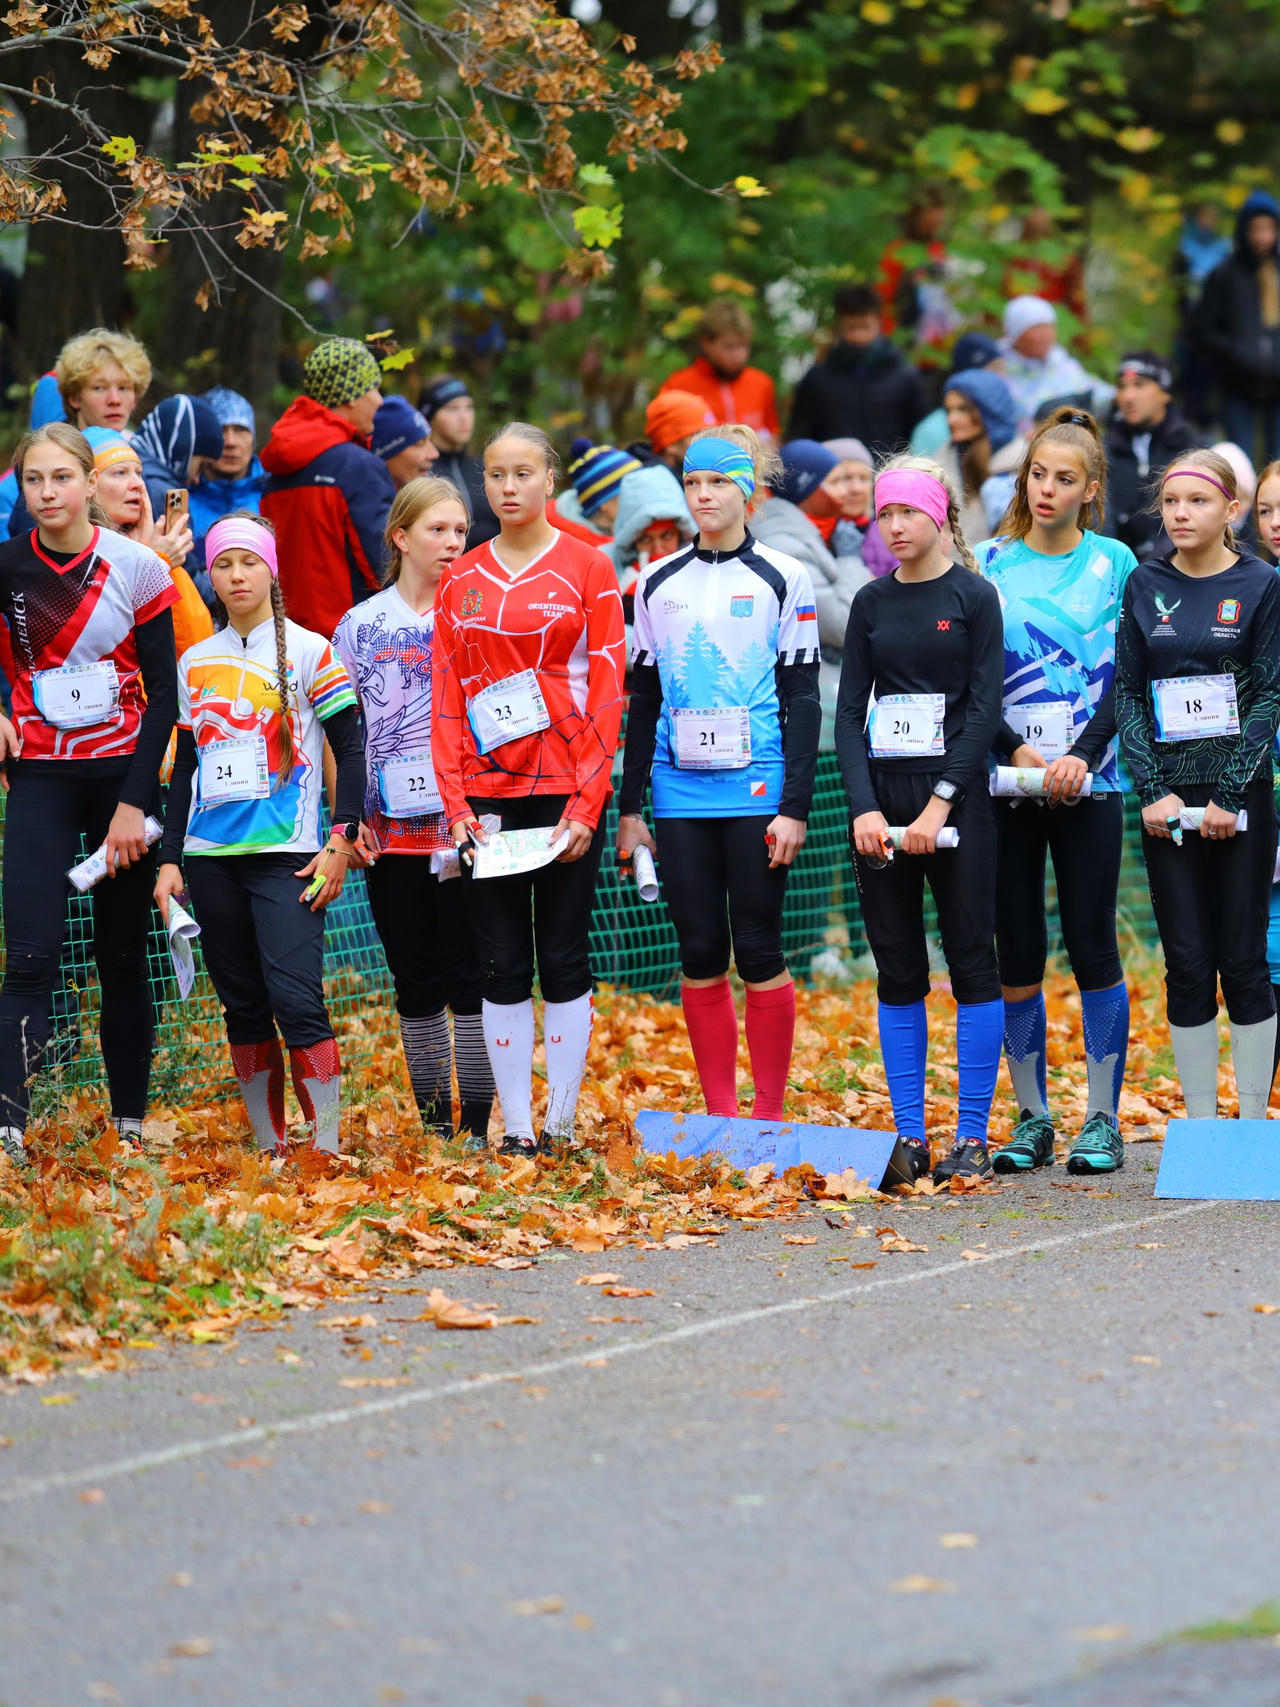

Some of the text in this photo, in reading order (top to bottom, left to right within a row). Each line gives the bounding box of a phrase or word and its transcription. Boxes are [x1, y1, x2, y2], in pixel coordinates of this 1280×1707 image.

[528, 603, 576, 614] ORIENTEERING
[542, 610, 563, 618] TEAM
[71, 689, 81, 703] 9
[495, 705, 512, 722] 23
[1185, 699, 1202, 714] 18
[893, 720, 910, 735] 20
[1026, 725, 1042, 739] 19
[699, 732, 716, 746] 21
[216, 764, 232, 780] 24
[408, 777, 426, 792] 22
